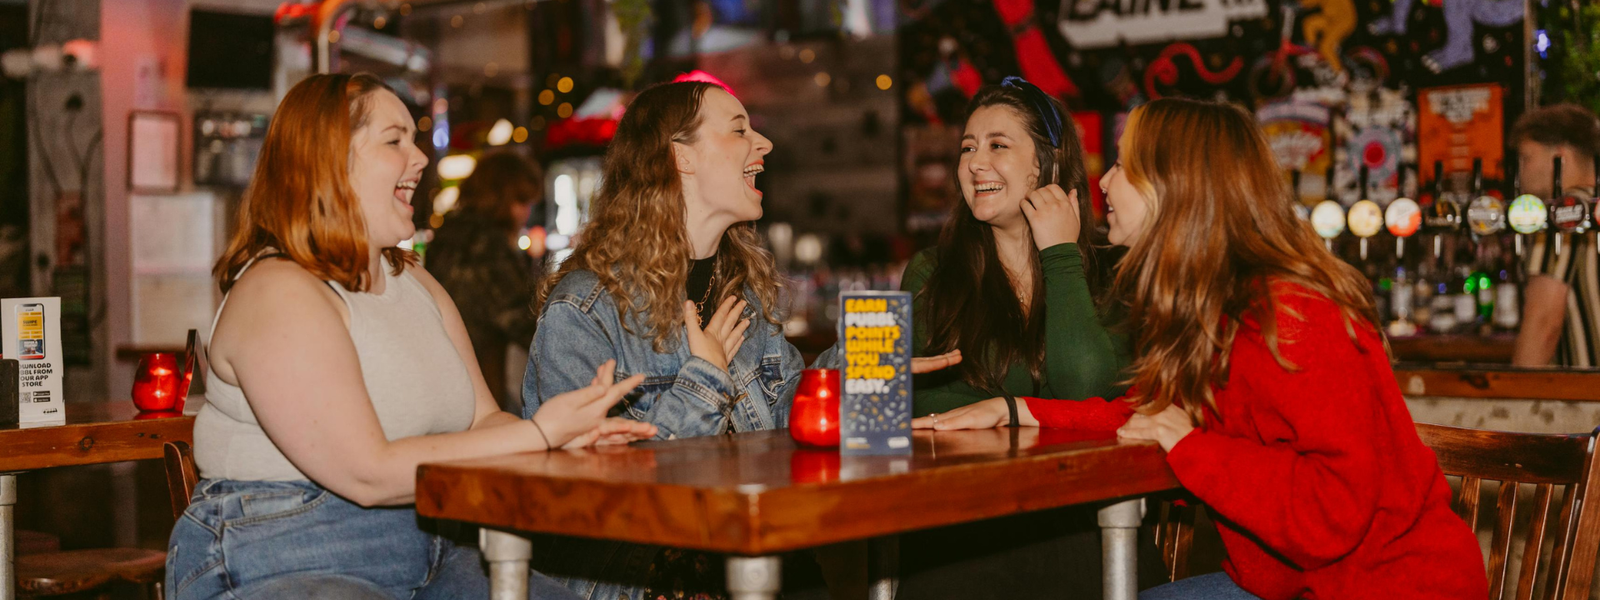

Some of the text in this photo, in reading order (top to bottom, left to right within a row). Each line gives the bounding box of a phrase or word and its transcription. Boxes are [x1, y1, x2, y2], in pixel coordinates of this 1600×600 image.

[845, 298, 887, 312] EARN
[845, 325, 900, 339] POINTS
[845, 339, 894, 353] WHILE
[845, 352, 879, 366] YOU
[845, 365, 896, 380] SPEND
[845, 378, 890, 394] EASY.
